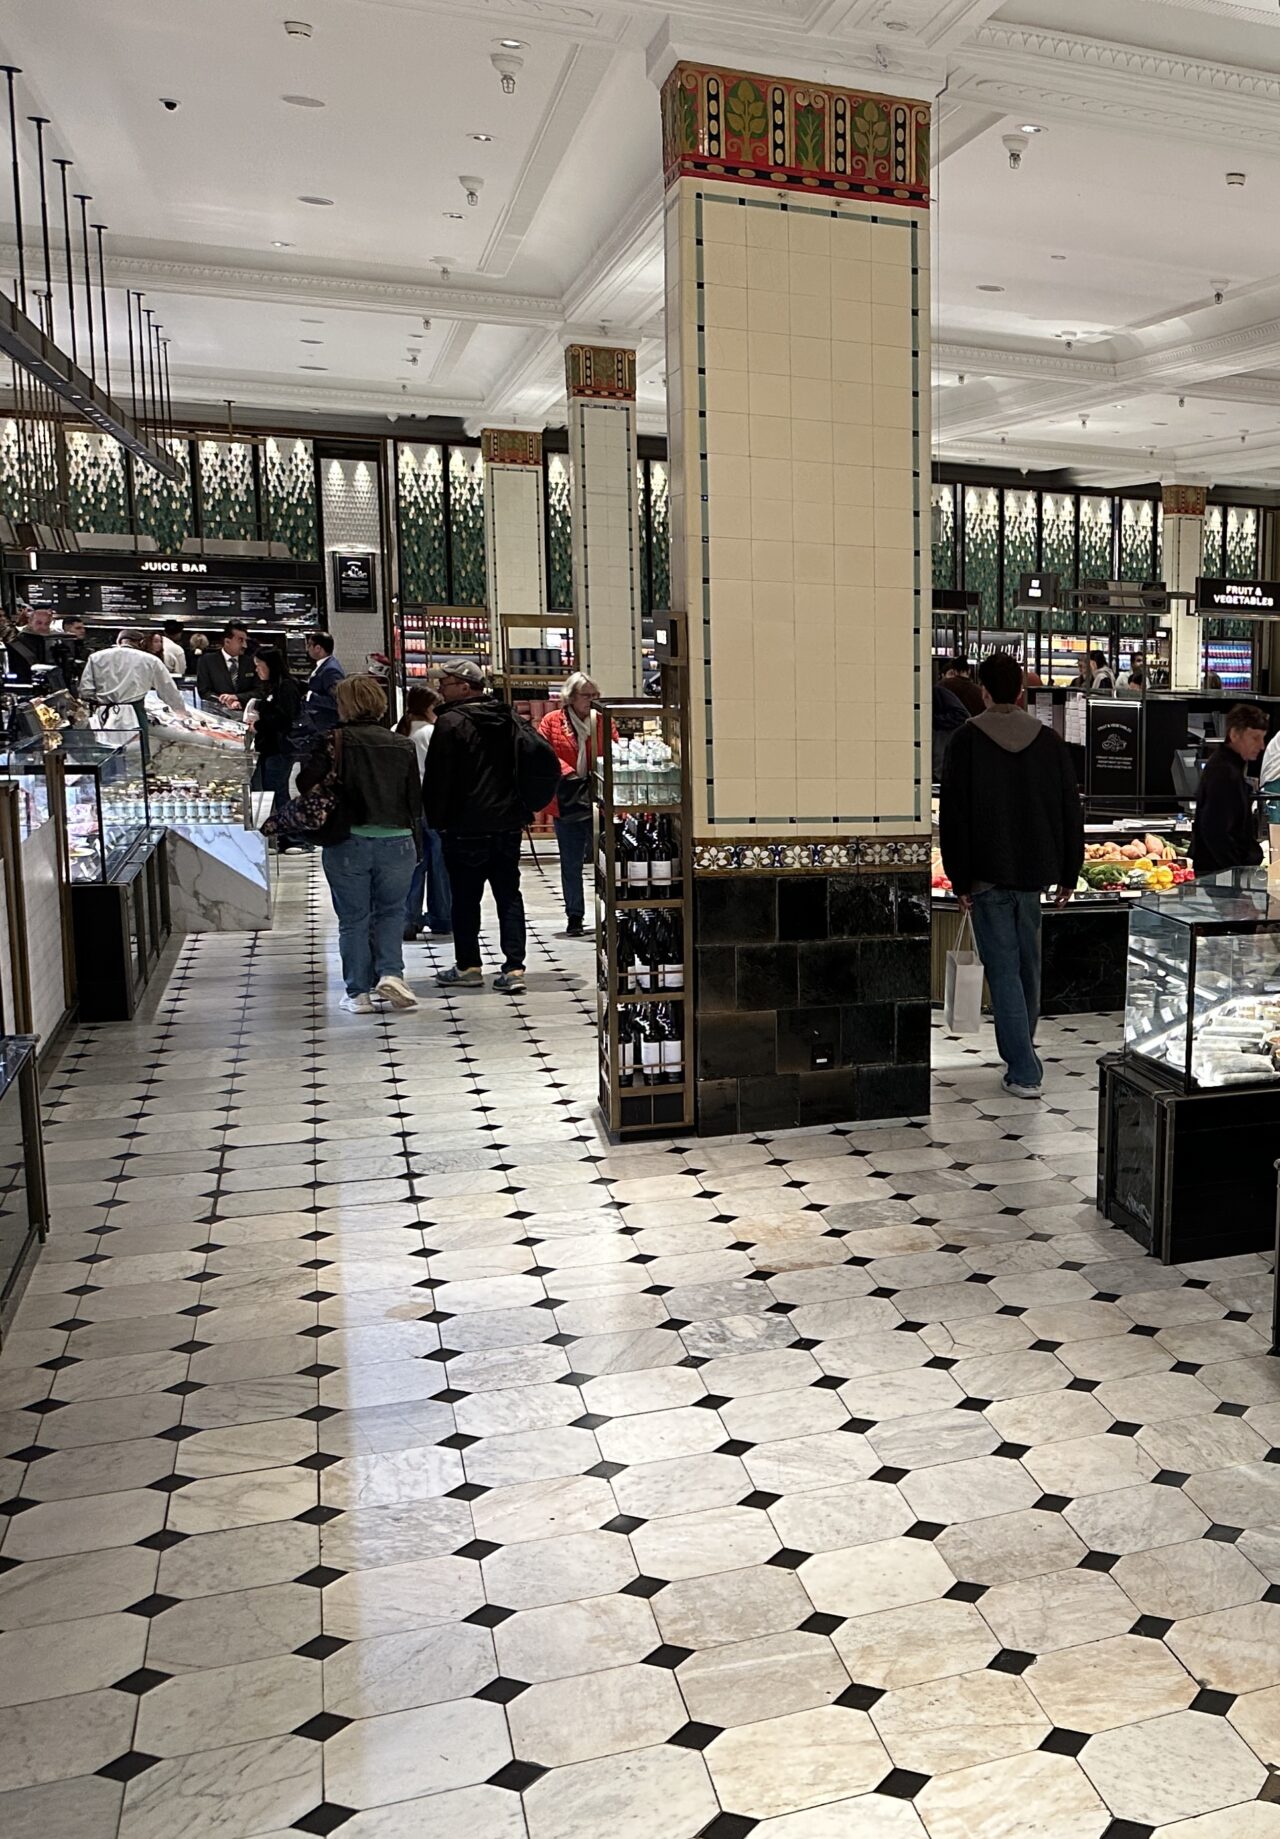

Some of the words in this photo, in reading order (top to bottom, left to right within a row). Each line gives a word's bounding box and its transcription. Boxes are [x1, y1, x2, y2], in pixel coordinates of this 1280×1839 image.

[141, 561, 178, 573] JUICE
[182, 563, 207, 573] BAR
[1225, 585, 1254, 596] FRUIT
[1255, 586, 1262, 596] &
[1213, 594, 1274, 607] VEGETABLES
